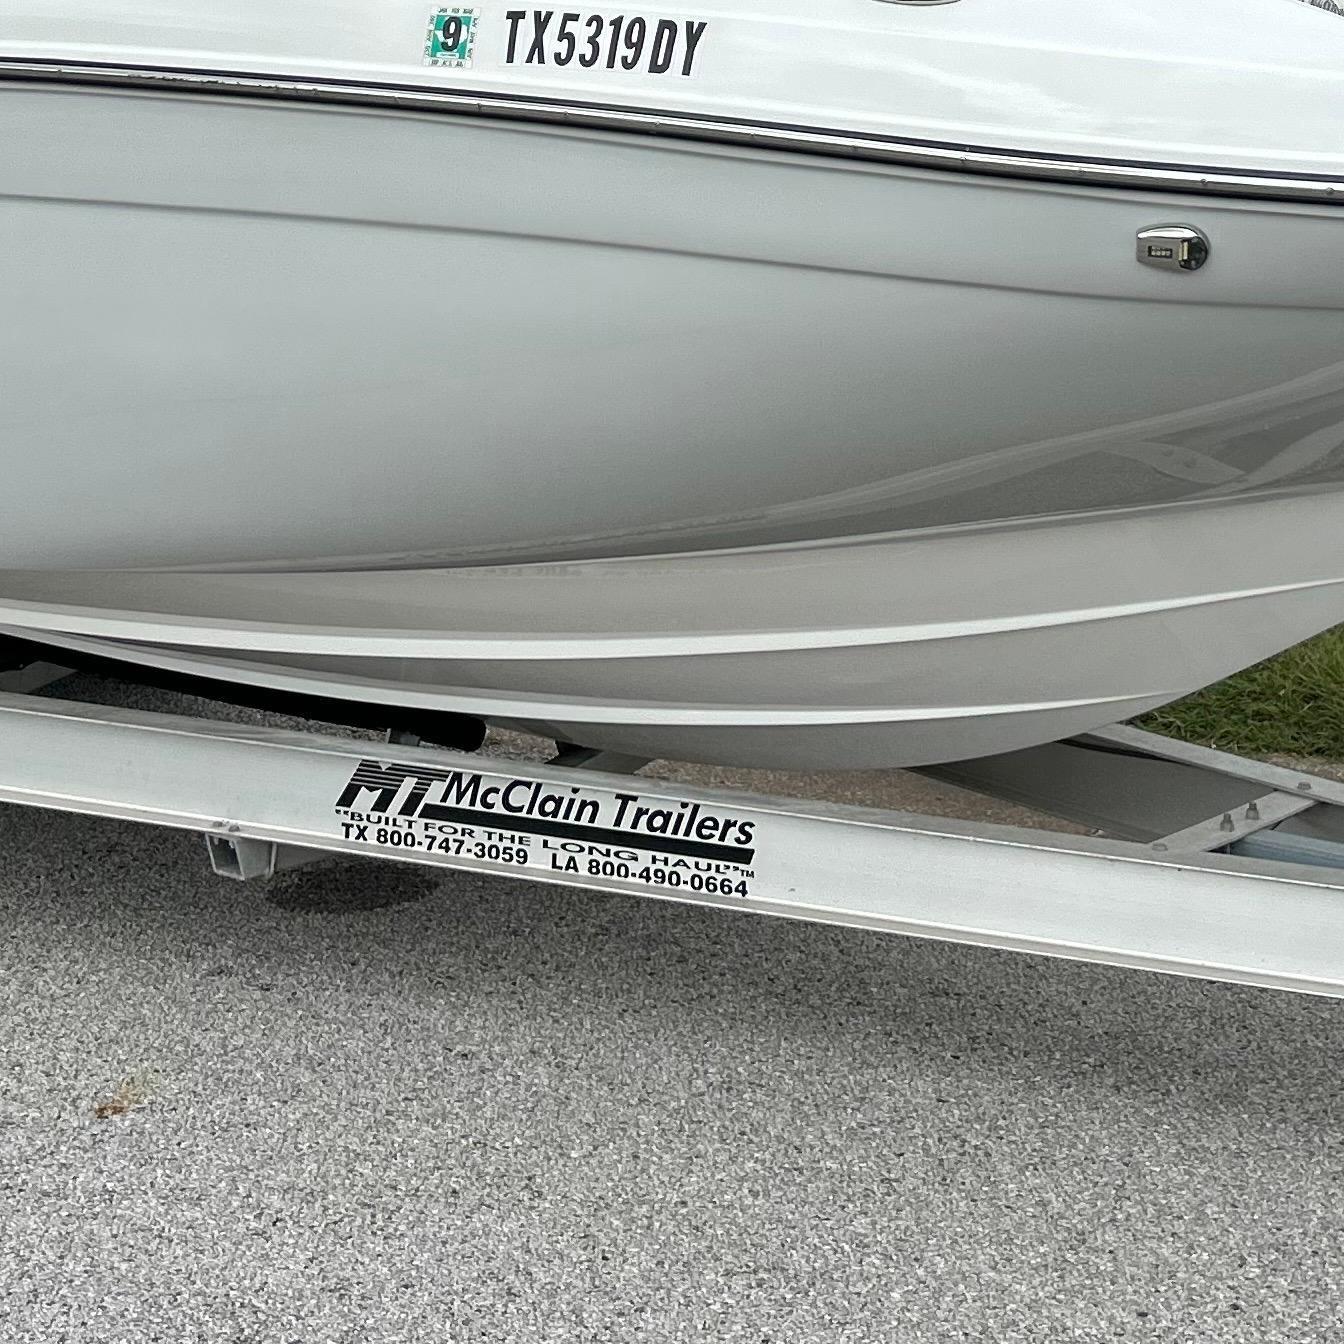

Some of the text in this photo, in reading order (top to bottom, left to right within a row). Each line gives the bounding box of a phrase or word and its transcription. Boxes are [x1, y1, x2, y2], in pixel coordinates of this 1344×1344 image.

[441, 16, 463, 52] 9
[506, 10, 707, 76] TX5319DY
[335, 759, 453, 817] MT
[440, 771, 756, 845] McClain Trailers
[341, 822, 749, 897] TX 800-747-3059 LA 800-490-0664
[424, 822, 475, 838] FOR
[483, 830, 532, 846] THE
[542, 839, 639, 862] LONG
